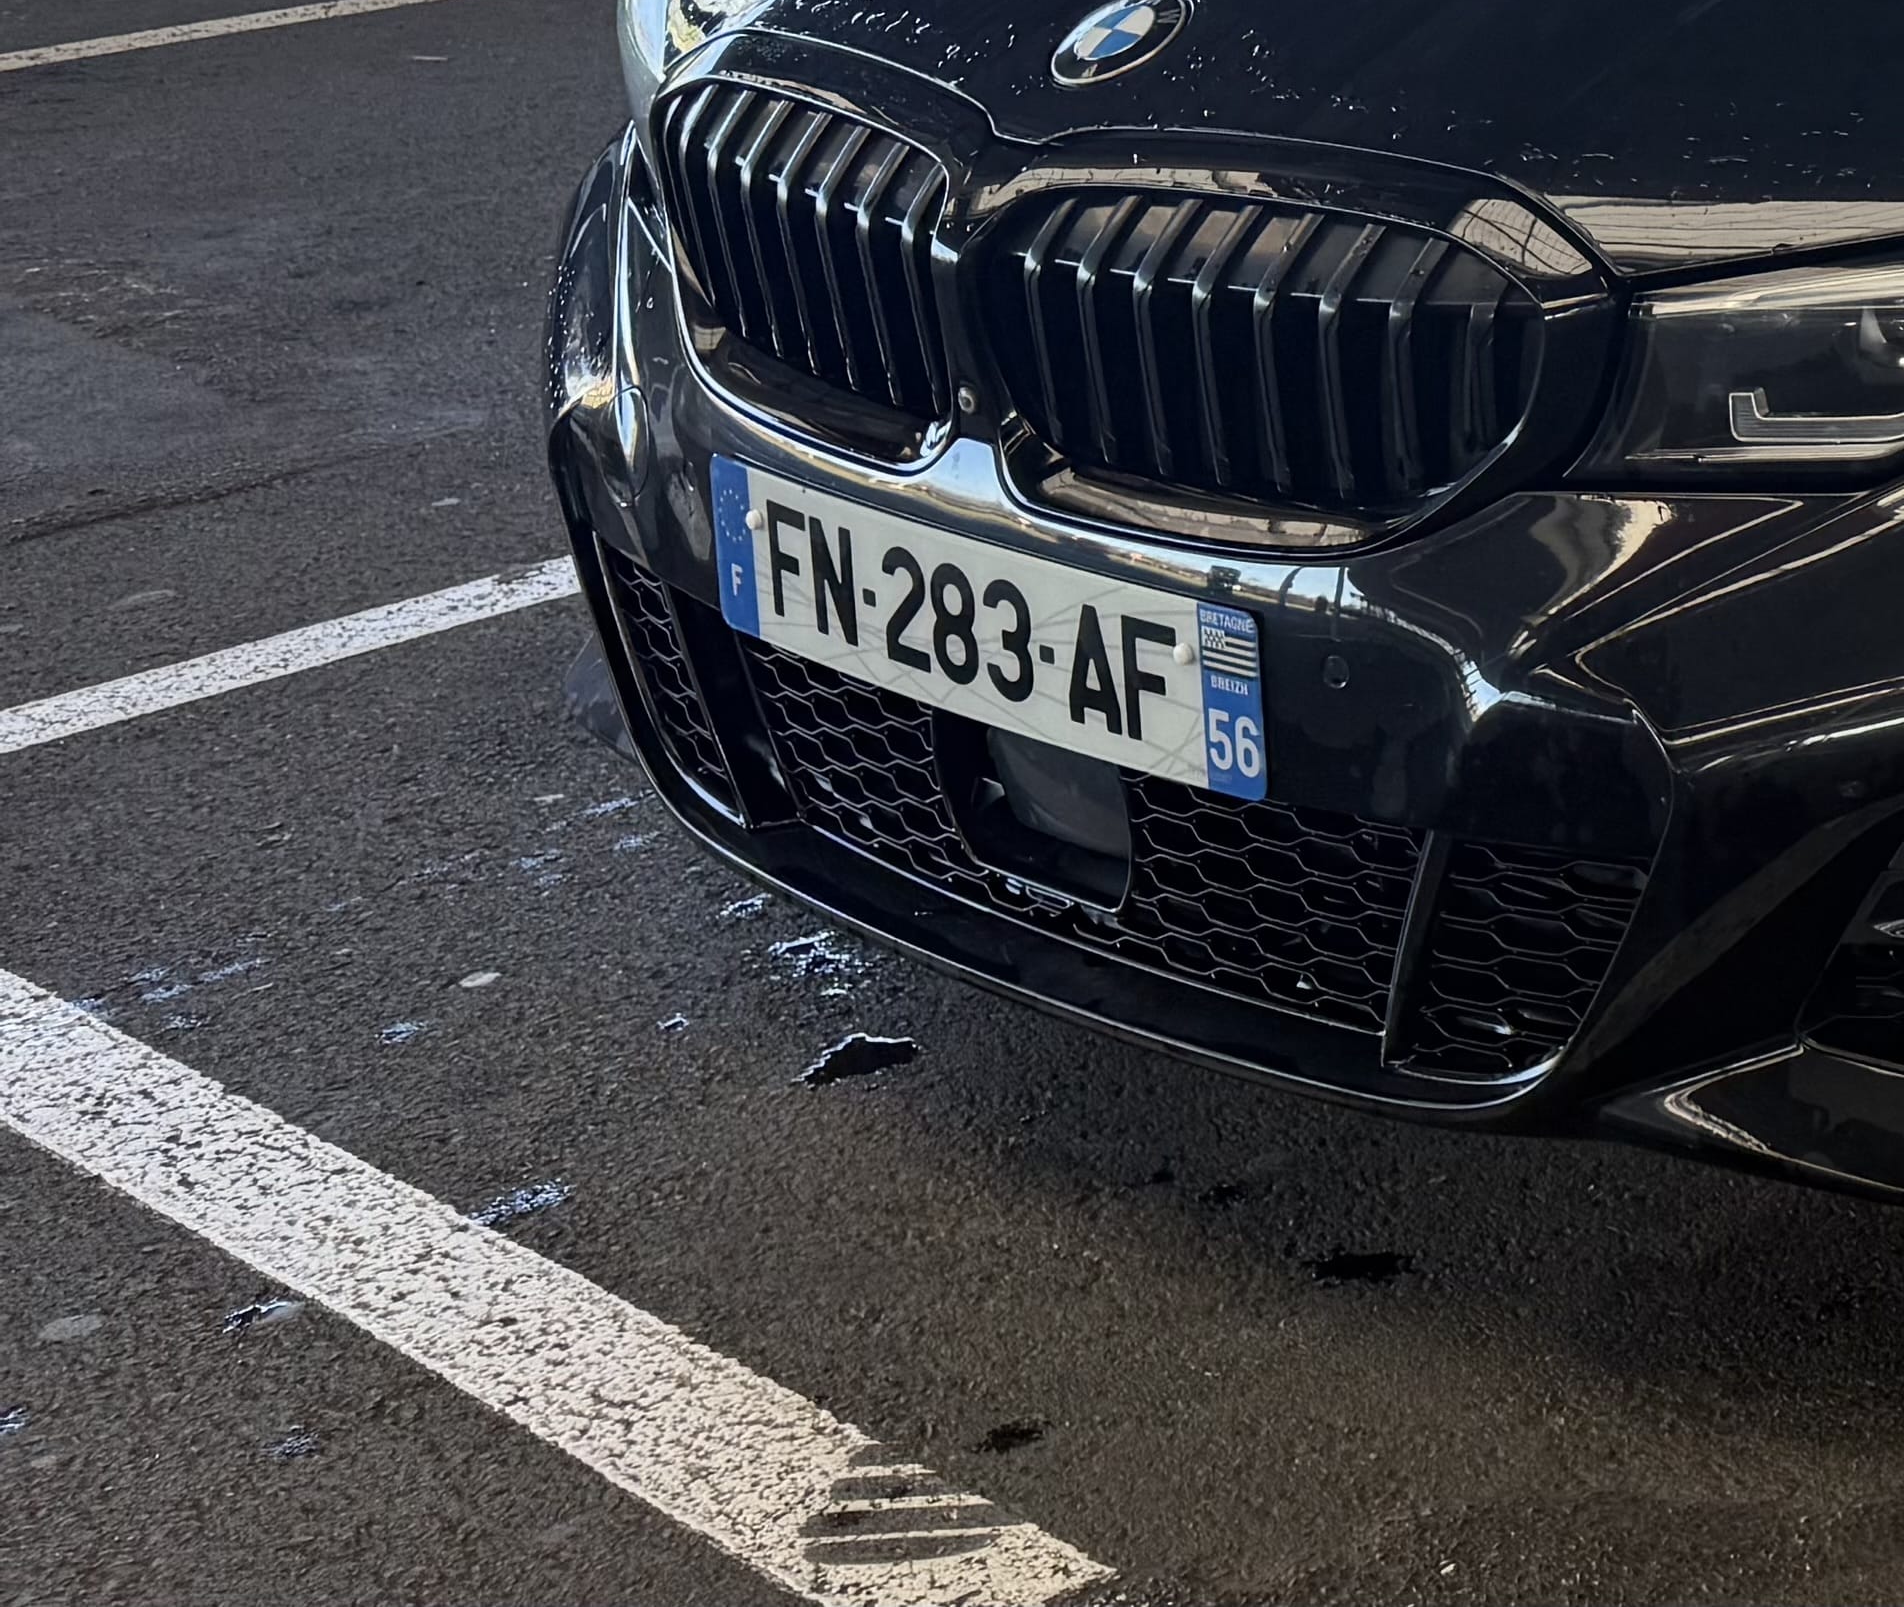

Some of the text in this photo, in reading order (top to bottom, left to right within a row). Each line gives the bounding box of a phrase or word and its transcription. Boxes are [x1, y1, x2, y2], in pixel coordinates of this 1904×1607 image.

[731, 562, 744, 597] F
[766, 499, 1177, 741] FN-283-AF
[1200, 608, 1256, 634] BRETAGNE
[1210, 675, 1249, 696] BREIZH
[1208, 707, 1261, 778] 56
